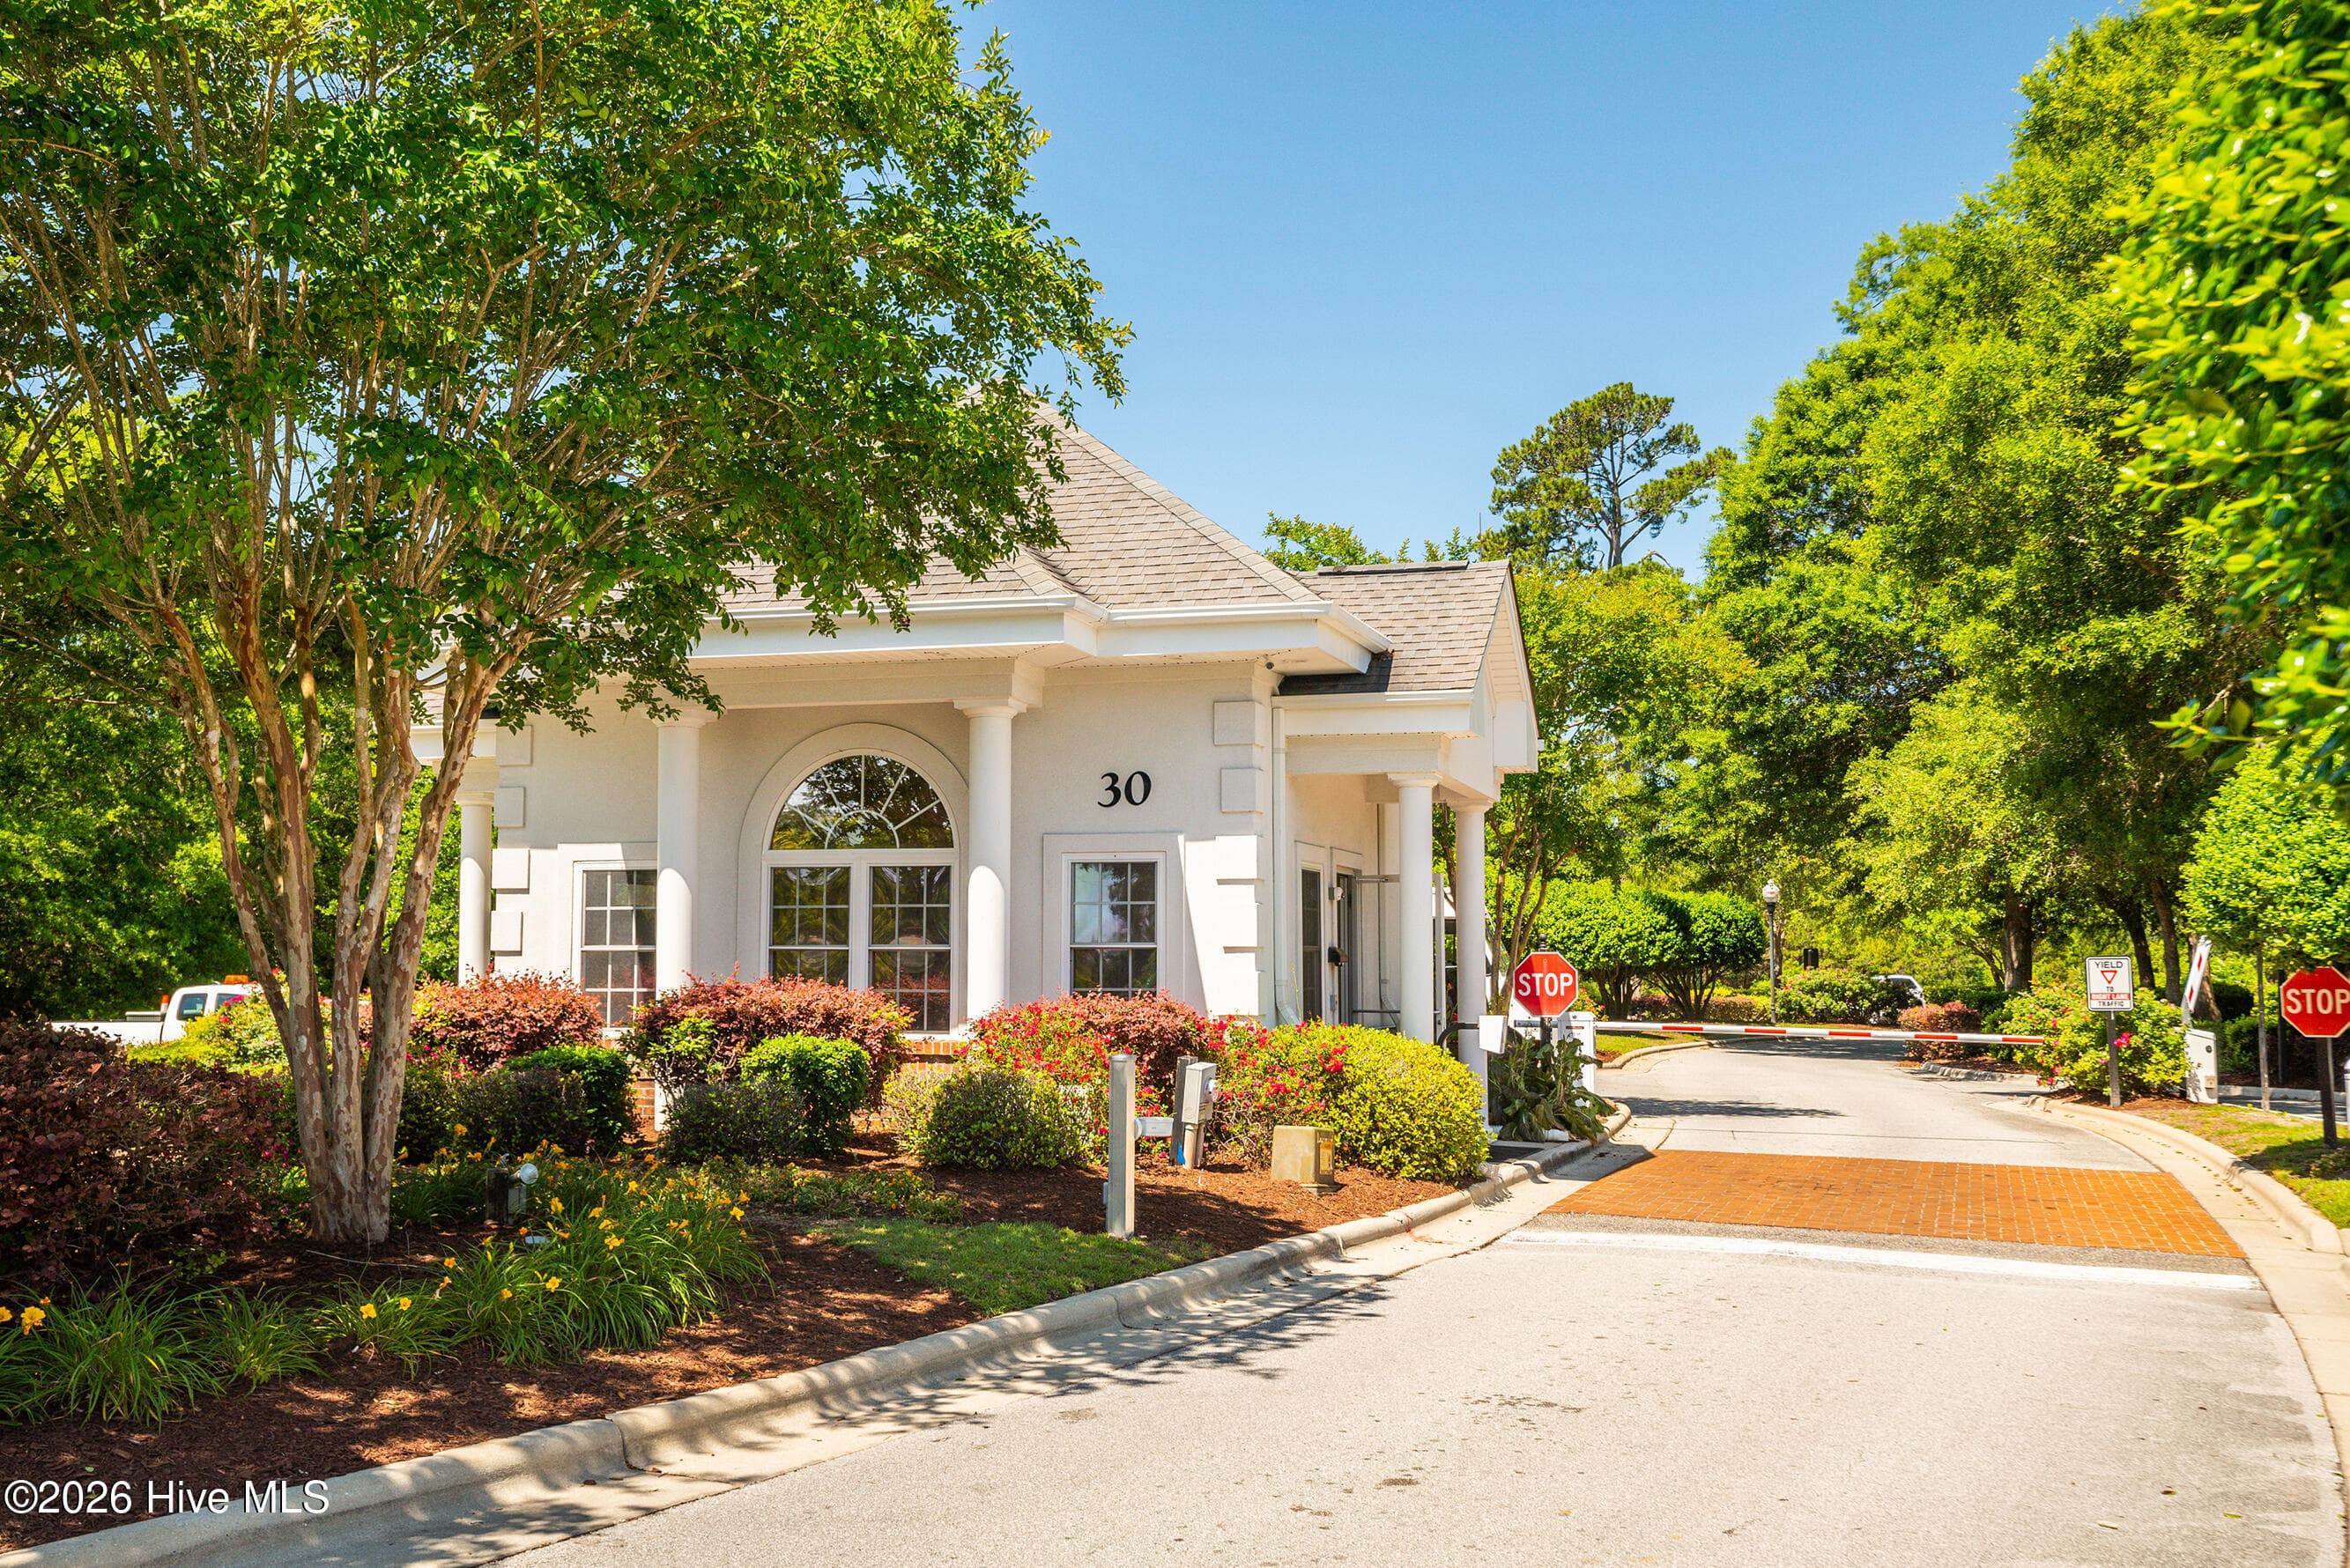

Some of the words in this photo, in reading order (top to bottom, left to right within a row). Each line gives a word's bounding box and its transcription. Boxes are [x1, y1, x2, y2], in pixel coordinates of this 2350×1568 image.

[1097, 770, 1152, 808] 30
[1517, 973, 1574, 996] STOP
[2286, 988, 2350, 1014] STOP
